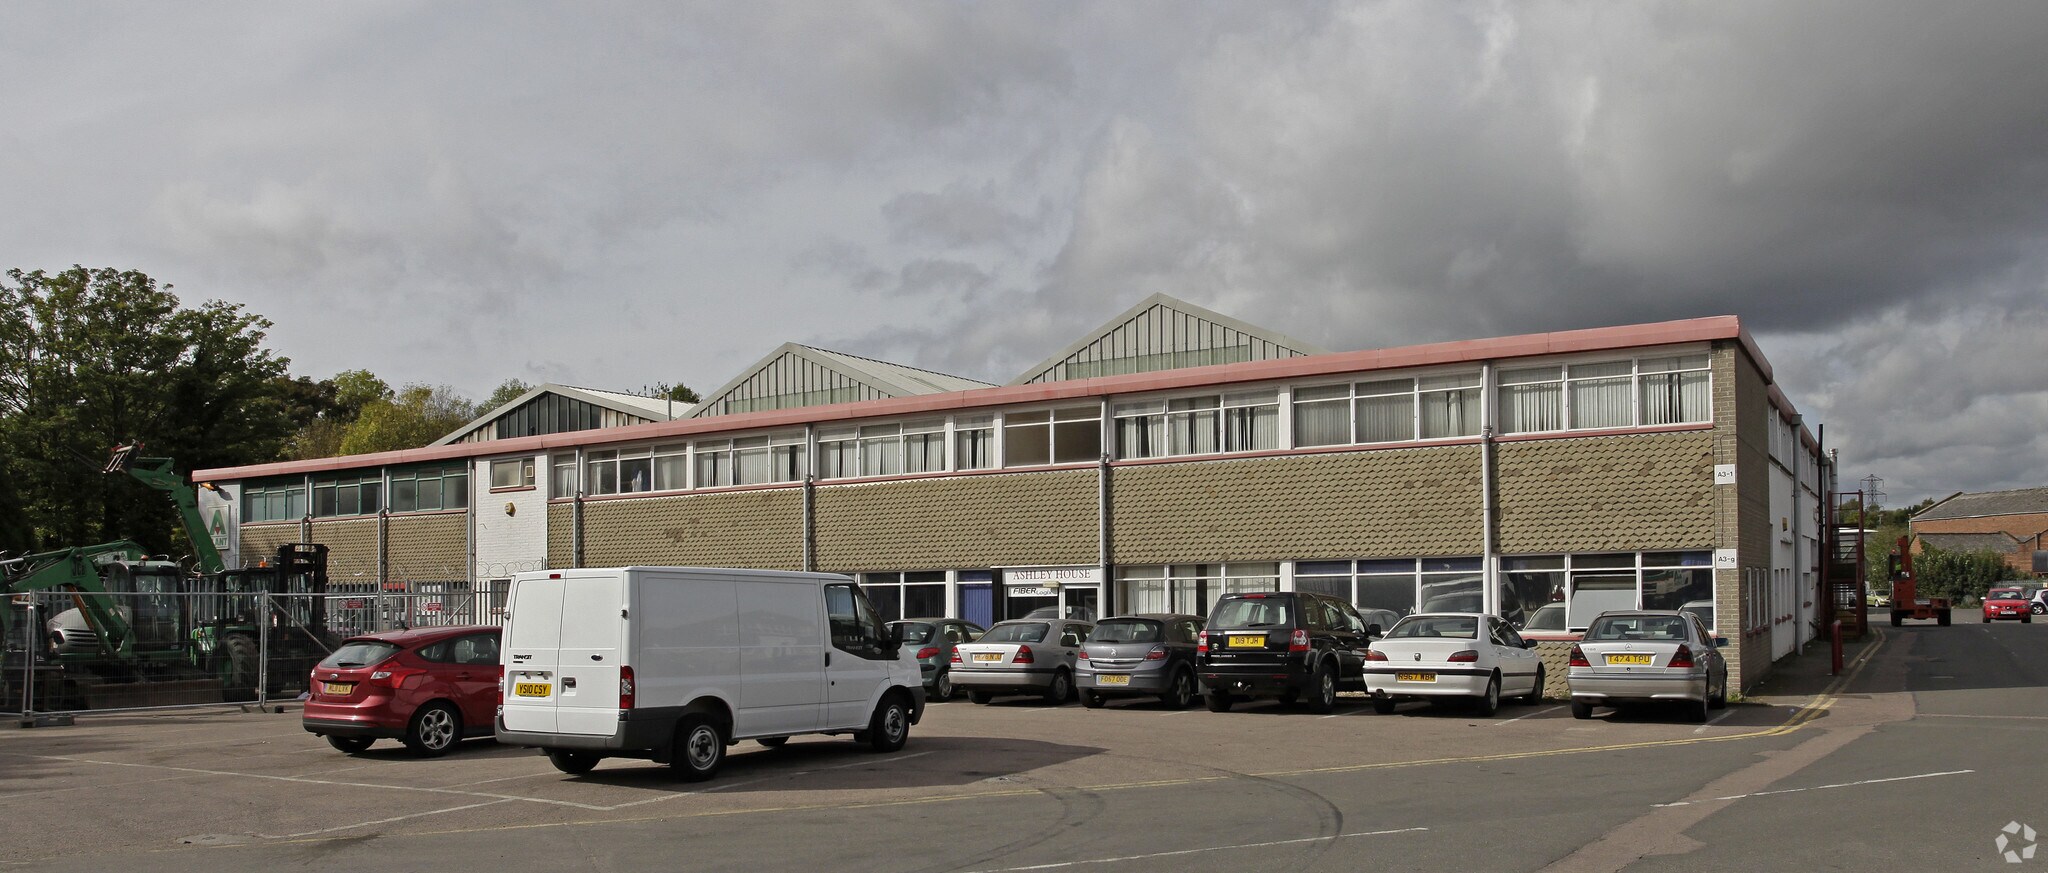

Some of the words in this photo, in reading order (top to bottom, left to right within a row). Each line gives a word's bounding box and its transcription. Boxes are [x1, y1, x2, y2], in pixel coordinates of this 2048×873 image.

[1013, 570, 1052, 580] ASHLEY
[1056, 569, 1091, 579] HOUSE
[1013, 587, 1036, 595] FIBER
[1609, 654, 1631, 662] T474
[1634, 654, 1650, 662] TPU
[519, 684, 533, 694] YS10
[534, 684, 548, 694] CSY
